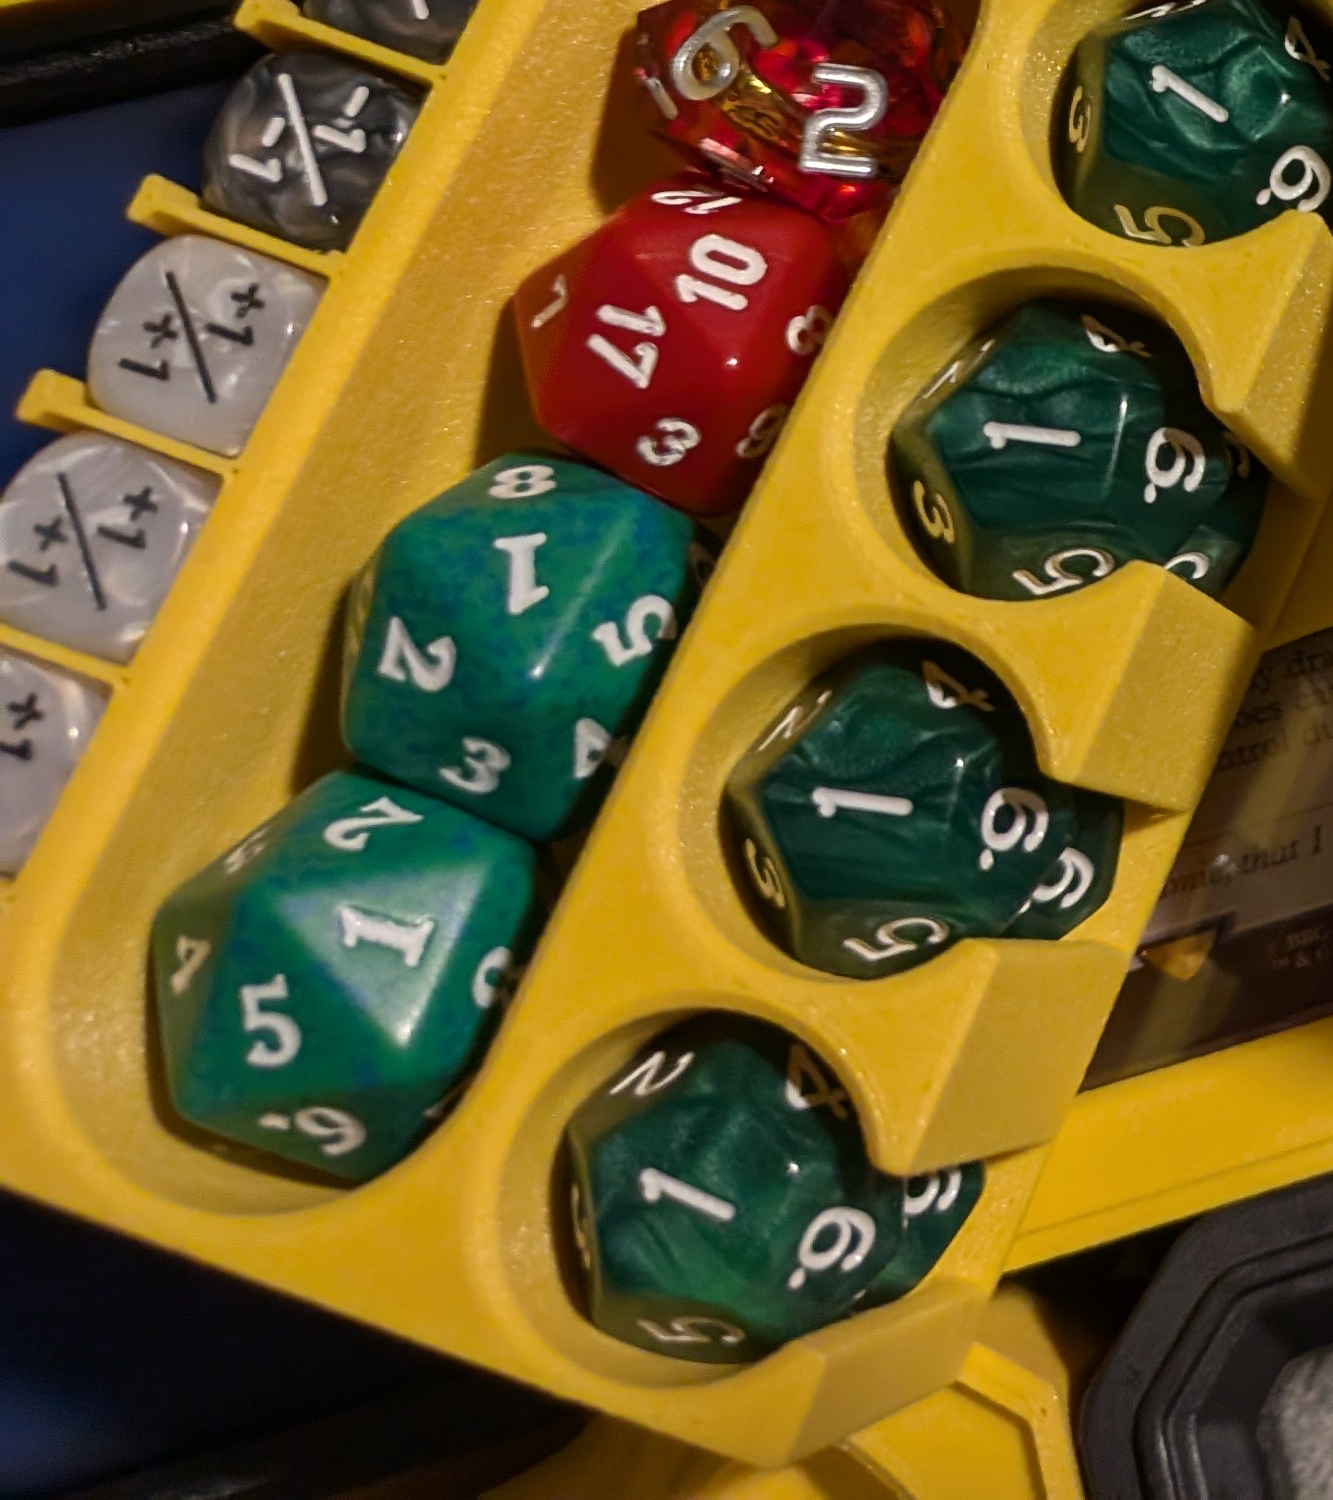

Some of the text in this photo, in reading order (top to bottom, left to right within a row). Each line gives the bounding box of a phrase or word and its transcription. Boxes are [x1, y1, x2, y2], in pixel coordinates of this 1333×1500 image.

[799, 63, 889, 177] 2
[1150, 65, 1229, 123] 1
[674, 233, 767, 311] 10
[586, 304, 666, 389] 17
[636, 417, 701, 465] 3
[983, 421, 1081, 450] 1
[488, 464, 557, 499] 8
[493, 532, 550, 615] 1
[1011, 547, 1115, 596] 5
[377, 616, 456, 692] 2
[591, 594, 678, 667] 5
[439, 736, 512, 795] 3
[322, 796, 425, 851] 2
[812, 785, 914, 818] 1
[1241, 837, 1299, 873] that
[1310, 824, 1323, 855] I
[335, 903, 437, 967] 1
[843, 917, 949, 961] 5
[238, 973, 301, 1067] 5
[638, 1167, 736, 1222] 1
